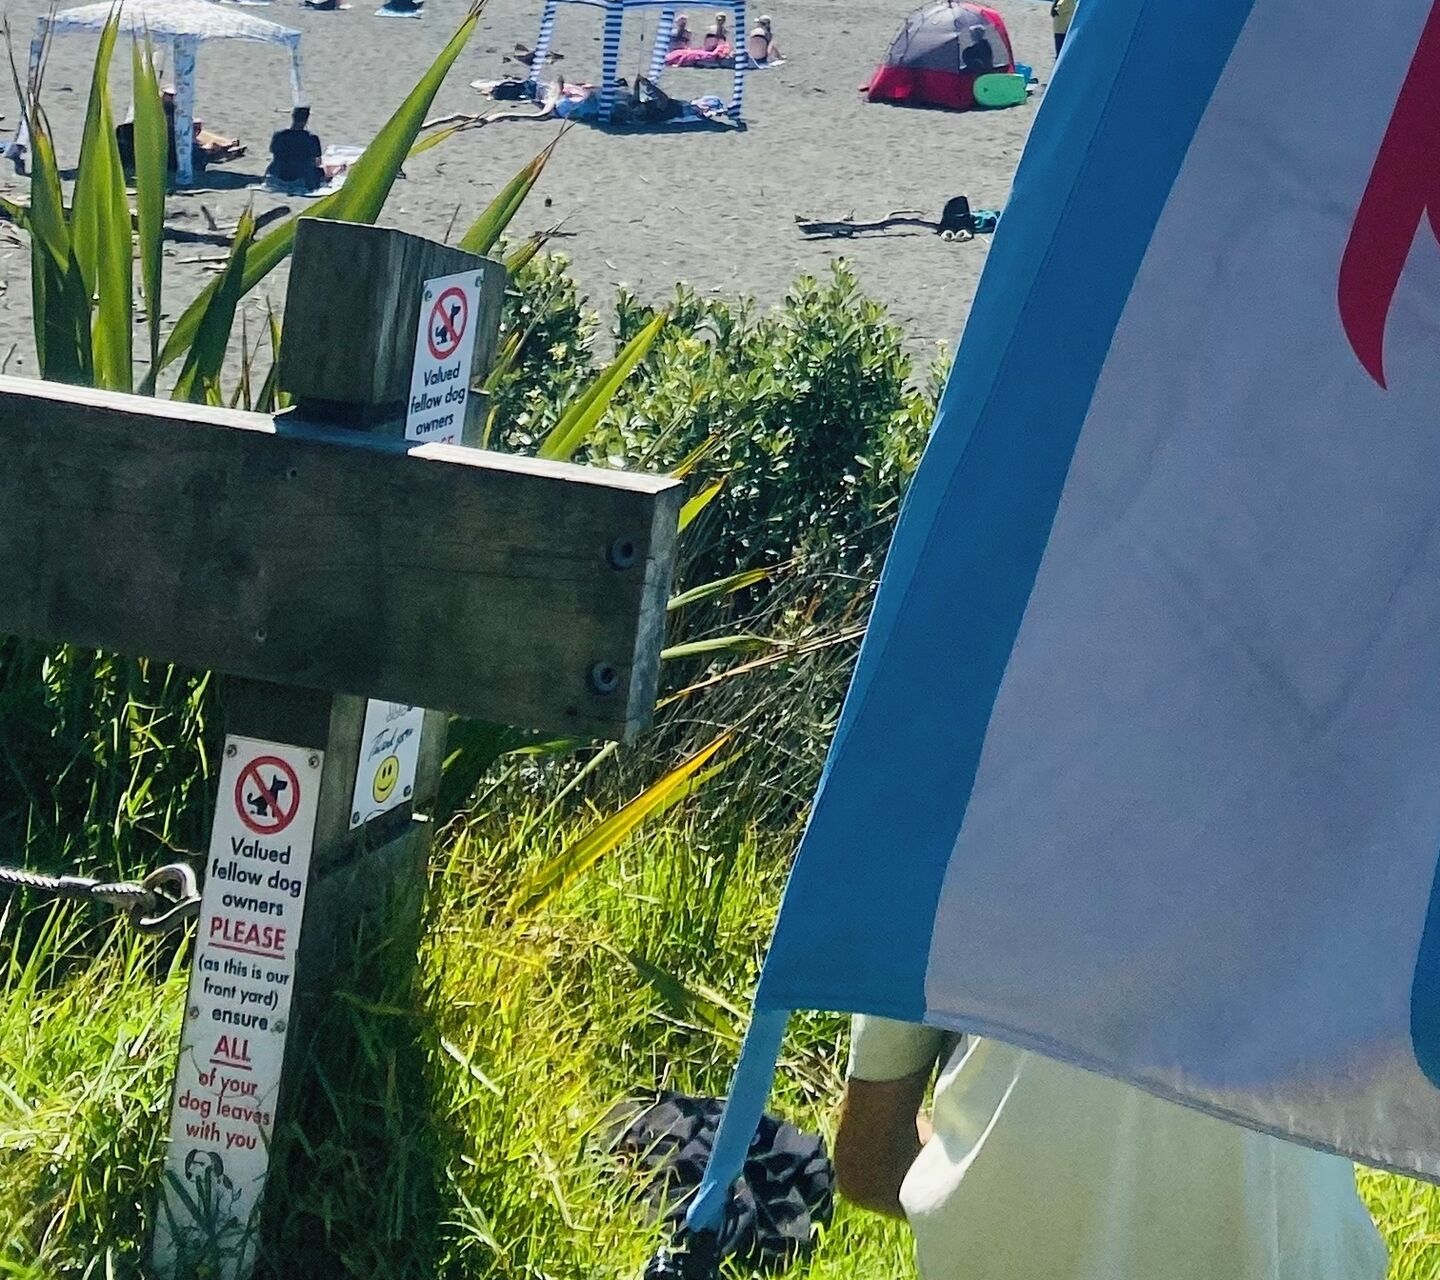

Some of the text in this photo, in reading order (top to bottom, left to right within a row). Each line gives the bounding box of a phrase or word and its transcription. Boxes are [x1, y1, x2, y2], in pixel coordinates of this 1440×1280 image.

[424, 360, 461, 387] Valued
[410, 385, 466, 415] fellow dog
[415, 414, 454, 436] owners
[231, 836, 291, 865] Valued
[212, 858, 302, 898] fellow dog
[222, 894, 284, 917] owners
[210, 916, 286, 951] PLEASE
[198, 953, 290, 986] (as this is our
[204, 977, 279, 1011] front yard)
[212, 1008, 269, 1031] ensure
[213, 1035, 252, 1062] ALL
[198, 1067, 258, 1100] of your
[178, 1089, 270, 1126] dog leaves
[186, 1120, 257, 1151] with you
